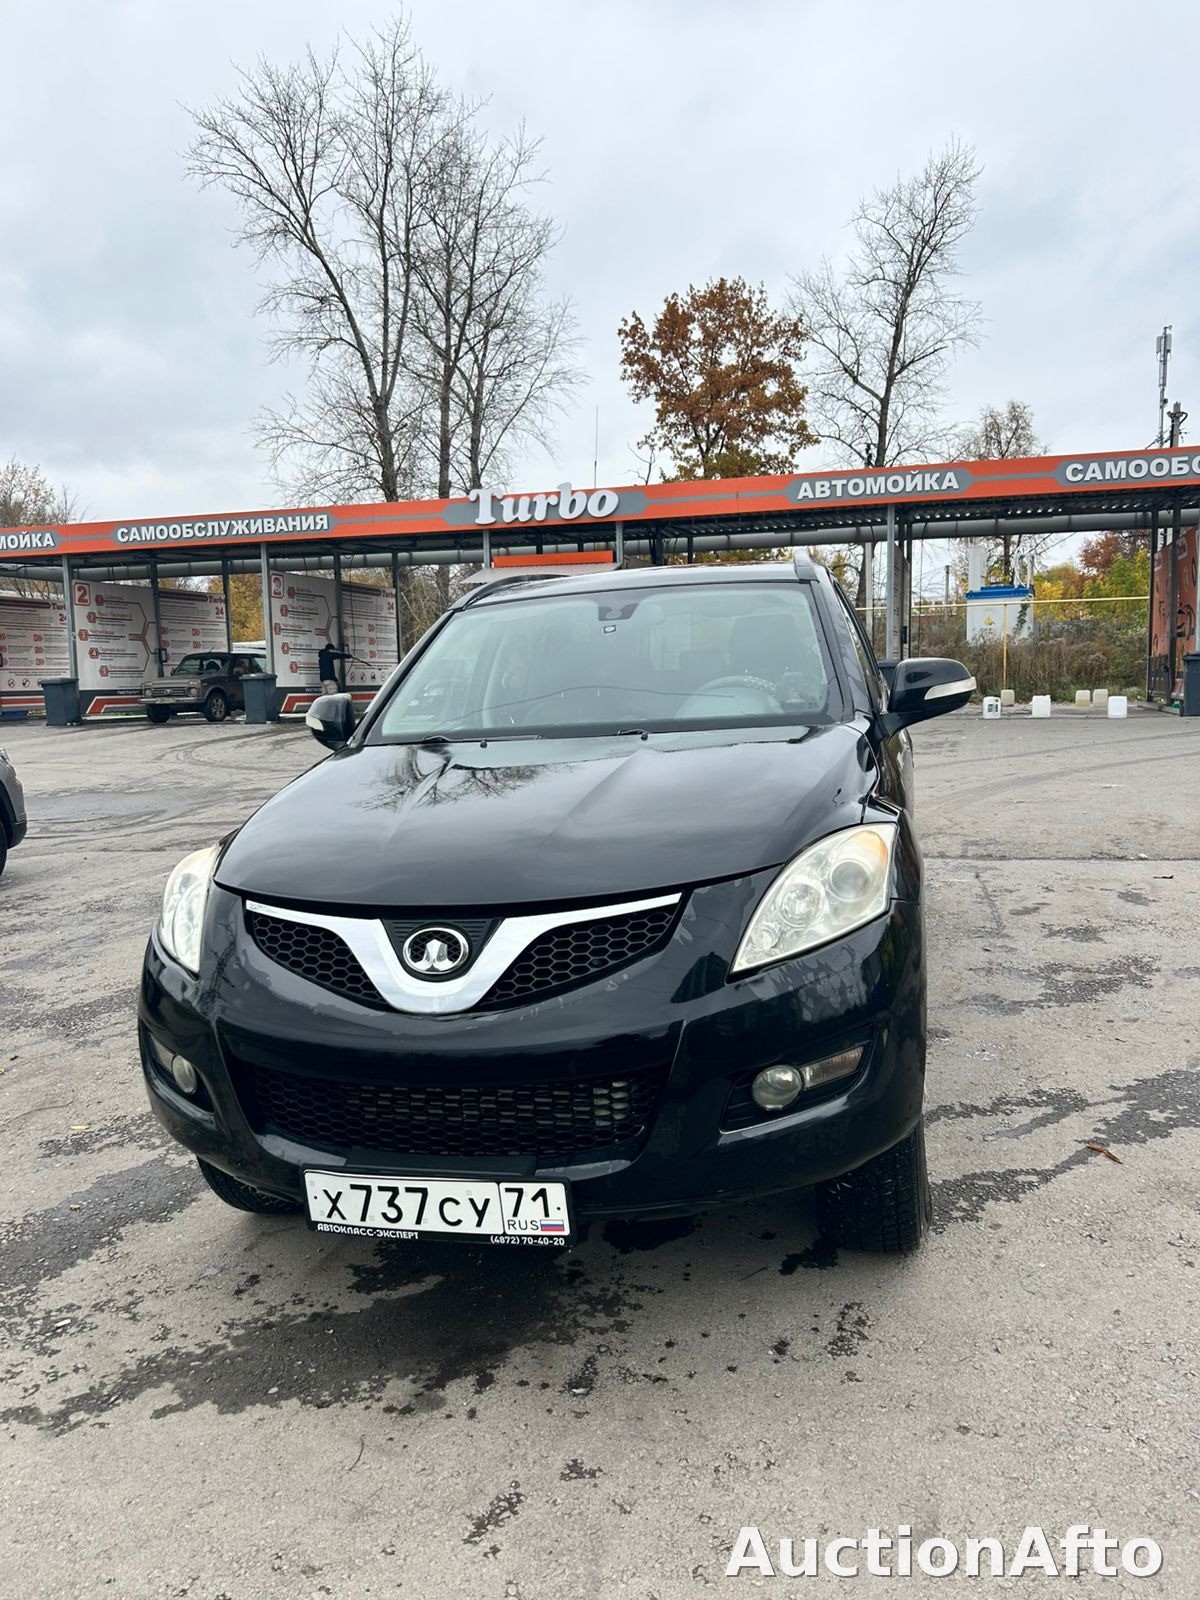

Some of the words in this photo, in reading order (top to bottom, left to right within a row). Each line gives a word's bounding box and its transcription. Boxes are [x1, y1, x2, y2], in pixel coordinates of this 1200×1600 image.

[796, 470, 959, 500] АВТОМОЙКА
[468, 482, 620, 525] Turbo
[117, 514, 329, 543] САМООБСЛУЖИВАНИЯ
[77, 586, 88, 603] 2
[273, 577, 281, 595] 2
[505, 1187, 550, 1218] 71
[508, 1220, 539, 1231] RUS
[490, 1236, 520, 1245] (4872)
[522, 1236, 565, 1246] 70-40-20
